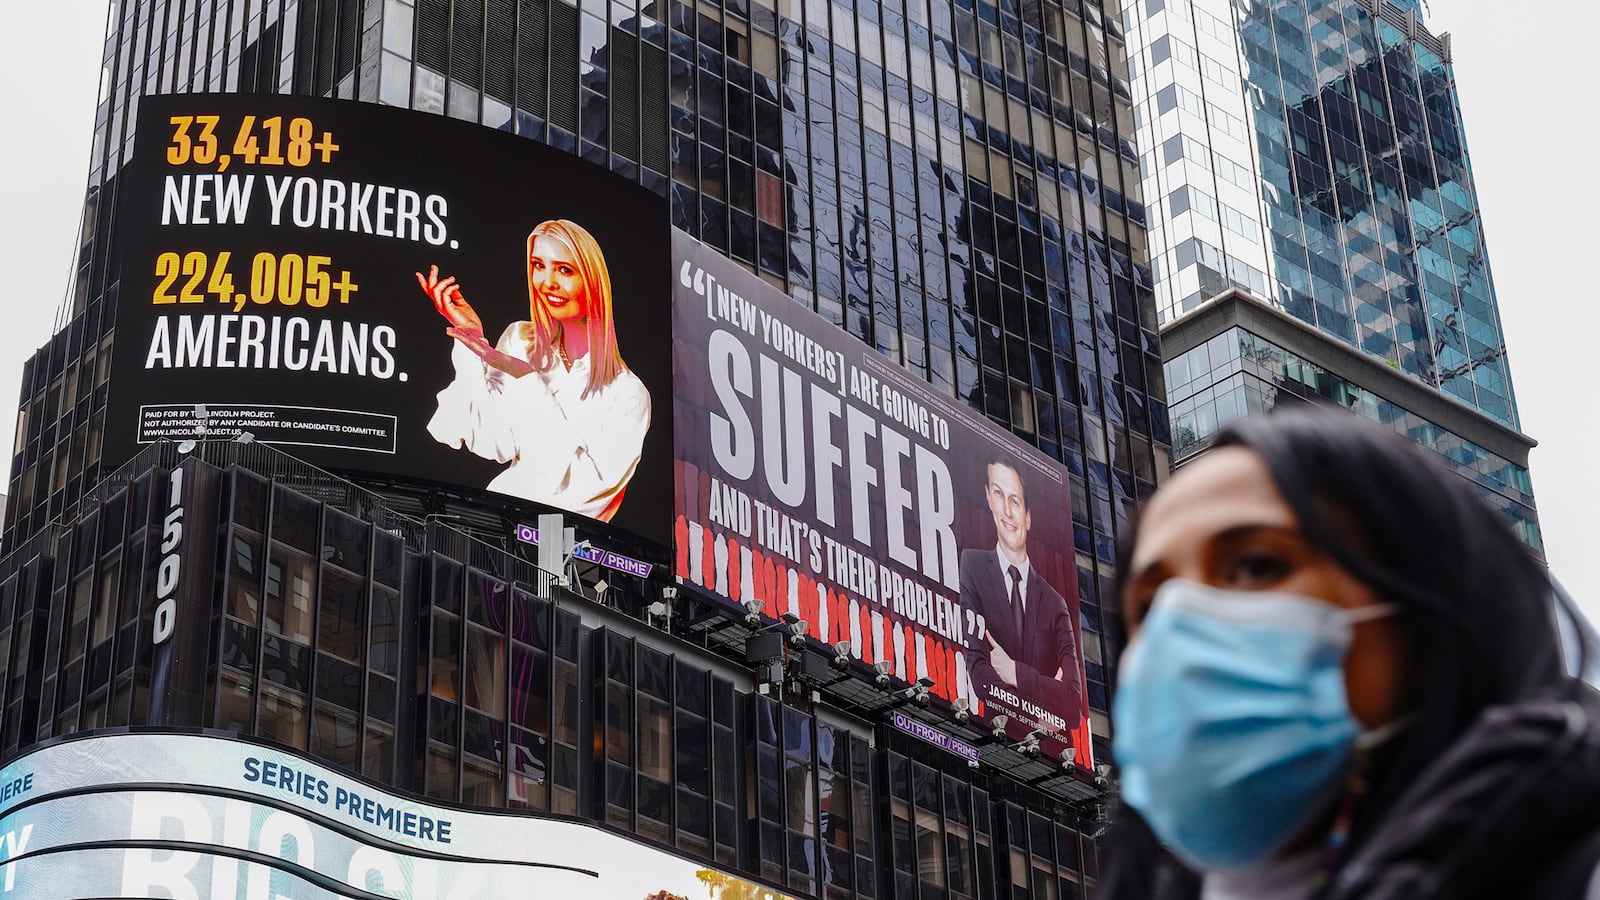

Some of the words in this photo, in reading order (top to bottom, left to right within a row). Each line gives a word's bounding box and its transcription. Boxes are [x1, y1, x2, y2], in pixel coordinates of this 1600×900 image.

[167, 115, 340, 172] 33,418+
[161, 174, 255, 225] NEW
[265, 174, 459, 250] YORKERS.
[153, 251, 359, 313] 224,005+
[144, 314, 409, 382] AMERICANS.
[760, 309, 846, 398] YORKERS]
[850, 365, 880, 410] ARE
[881, 384, 930, 440] GOING
[931, 412, 950, 450] TO
[143, 428, 241, 436] WWW.LINCOLNOJECT.US
[144, 420, 160, 428] NOT
[220, 419, 236, 427] ANY
[237, 419, 280, 428] CANDIDATE
[293, 422, 340, 432] CANDIDATE'S
[342, 425, 387, 437] COMMITTEE.
[145, 411, 162, 419] PAID
[163, 410, 179, 418] FOR
[180, 410, 190, 418] BY
[207, 410, 239, 418] LINCOLN
[240, 410, 275, 419] PROJECT.
[708, 329, 960, 594] SUFFER
[153, 467, 184, 645] 1500
[608, 556, 647, 576] PRIME
[709, 478, 752, 538] AND
[754, 500, 822, 574] THAT'S
[824, 535, 878, 603] THEIR
[985, 699, 1005, 714] VANITY
[989, 684, 1020, 708] JARED
[1021, 699, 1067, 731] KUSHNER
[896, 715, 947, 746] OUTFRONT
[952, 742, 977, 759] PRIME
[0, 772, 34, 803] IERE
[243, 757, 329, 804] SERIES
[335, 786, 452, 843] PREMIERE
